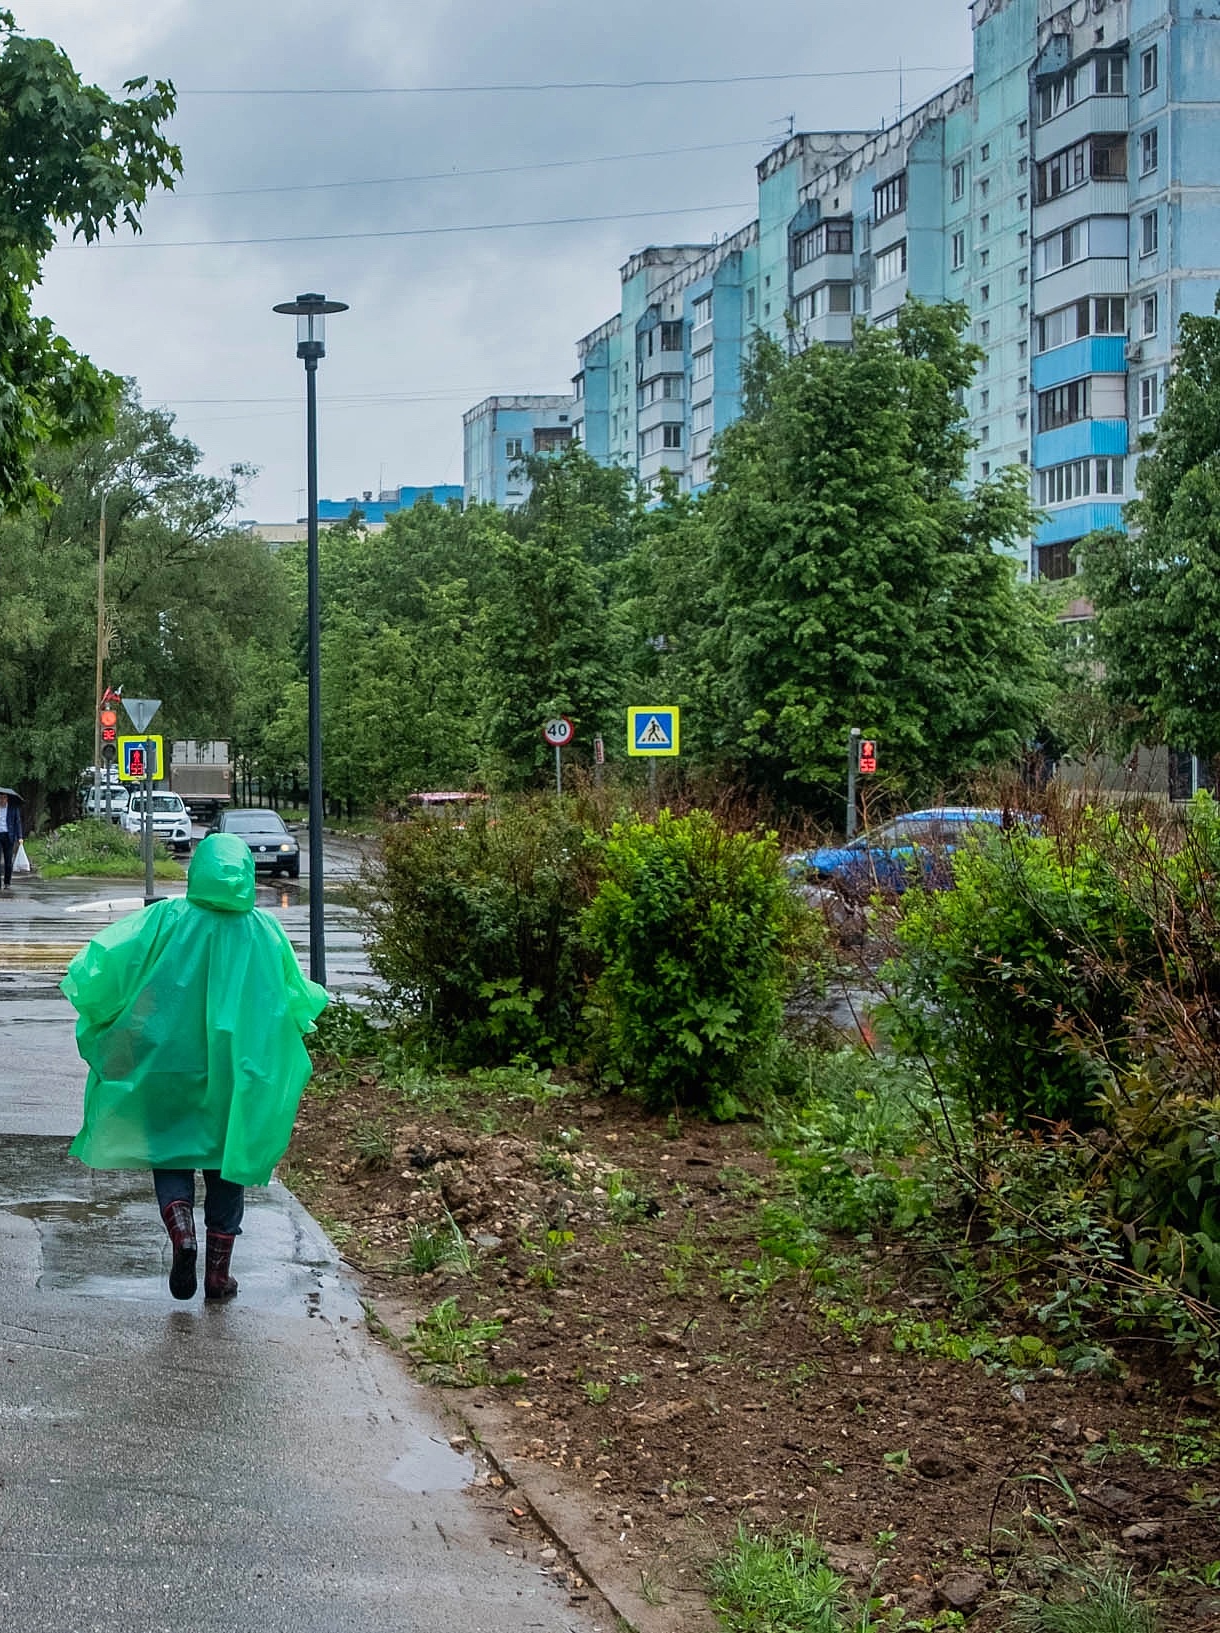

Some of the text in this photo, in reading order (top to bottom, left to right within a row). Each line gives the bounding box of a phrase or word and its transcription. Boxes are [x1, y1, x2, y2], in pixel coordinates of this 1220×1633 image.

[103, 730, 115, 741] 32
[548, 724, 567, 736] 40
[860, 758, 876, 772] 53
